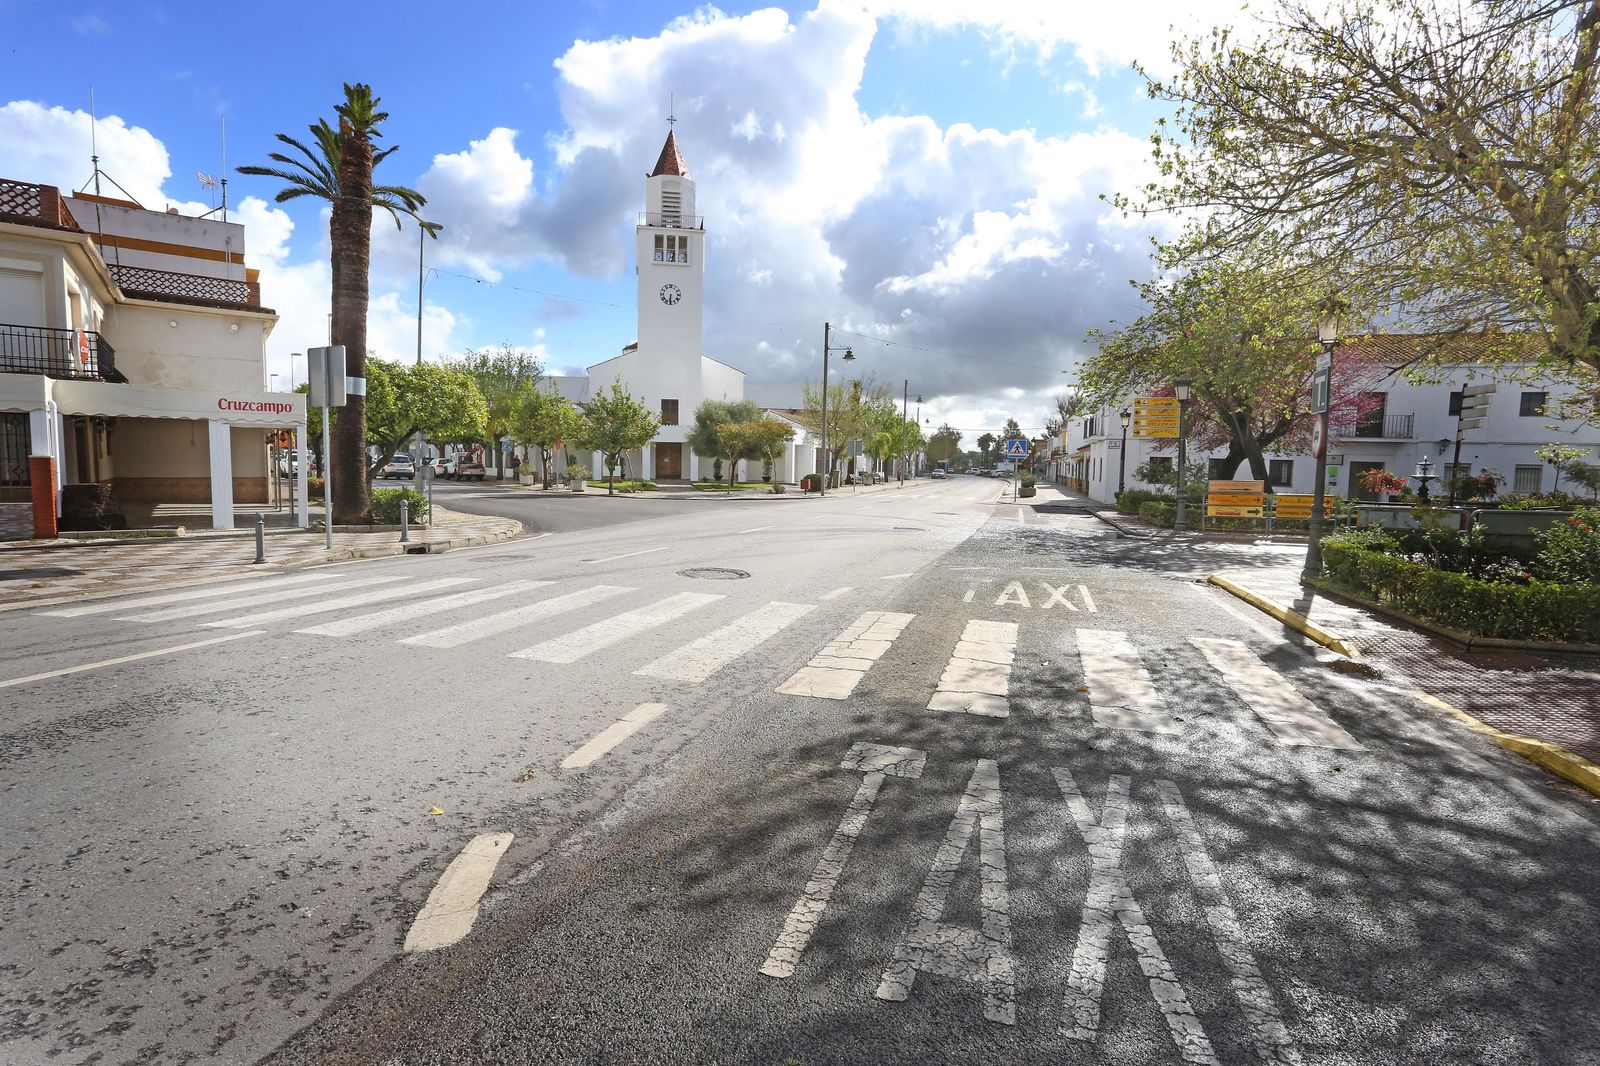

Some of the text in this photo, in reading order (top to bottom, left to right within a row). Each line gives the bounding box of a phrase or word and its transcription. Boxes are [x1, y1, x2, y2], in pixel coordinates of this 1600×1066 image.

[218, 398, 293, 414] Cruzcampo
[962, 578, 1098, 613] TAXI
[759, 741, 1304, 1066] TAXI
